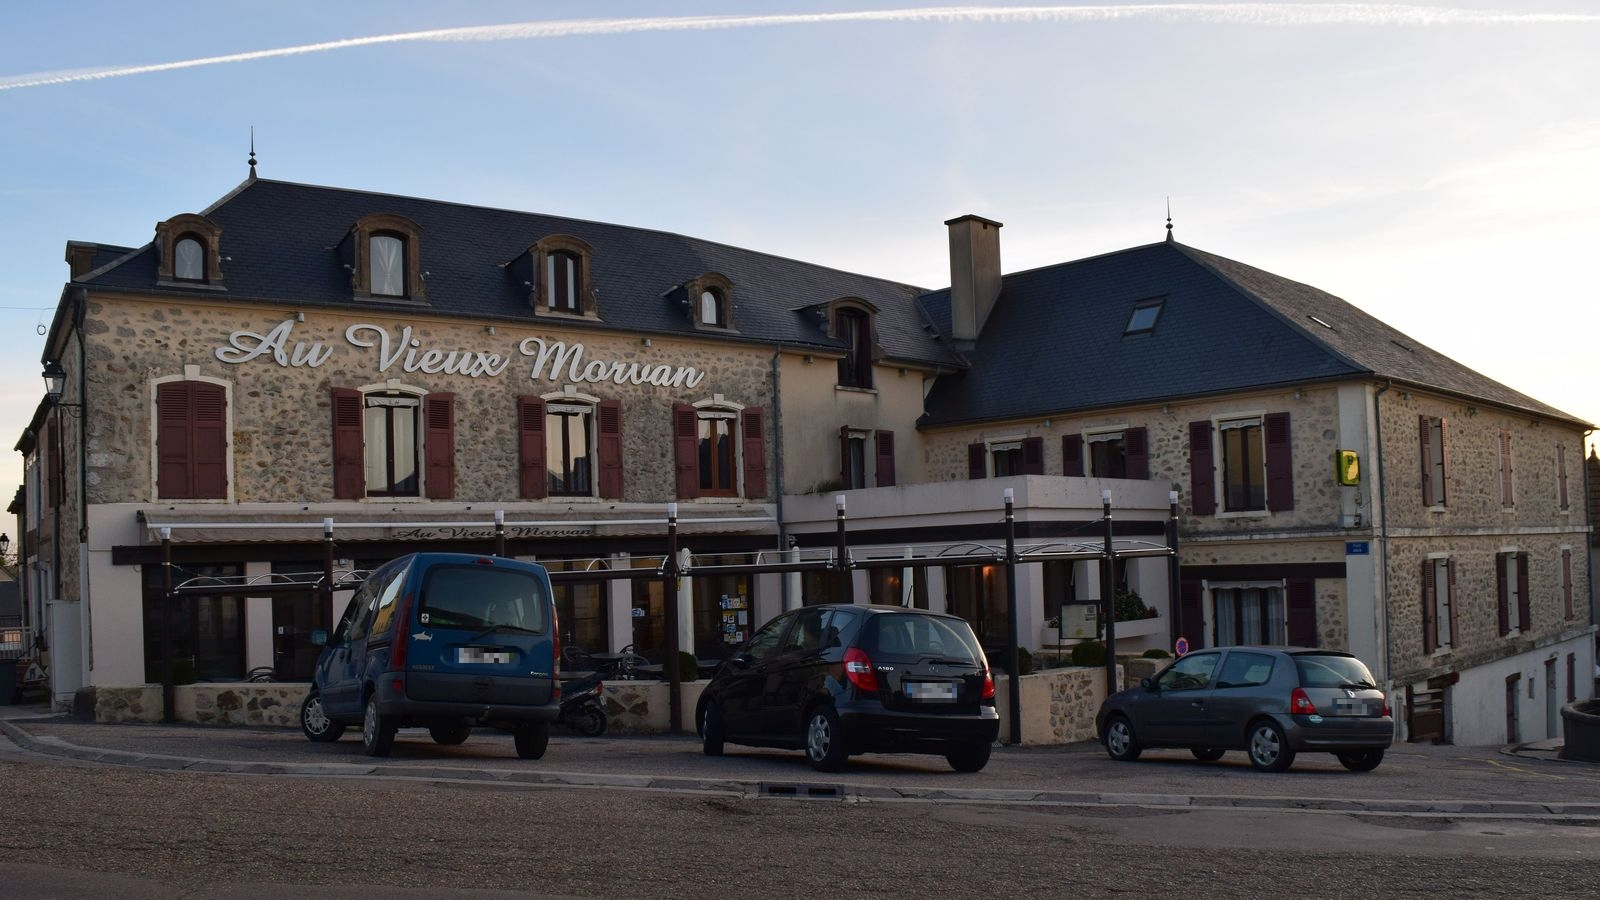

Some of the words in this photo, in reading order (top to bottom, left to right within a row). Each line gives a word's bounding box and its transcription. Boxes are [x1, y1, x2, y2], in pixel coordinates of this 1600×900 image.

[215, 319, 333, 368] Au
[345, 323, 510, 378] Vieux
[519, 337, 705, 388] Morvan
[392, 528, 436, 538] Au
[511, 527, 594, 537] Morvan
